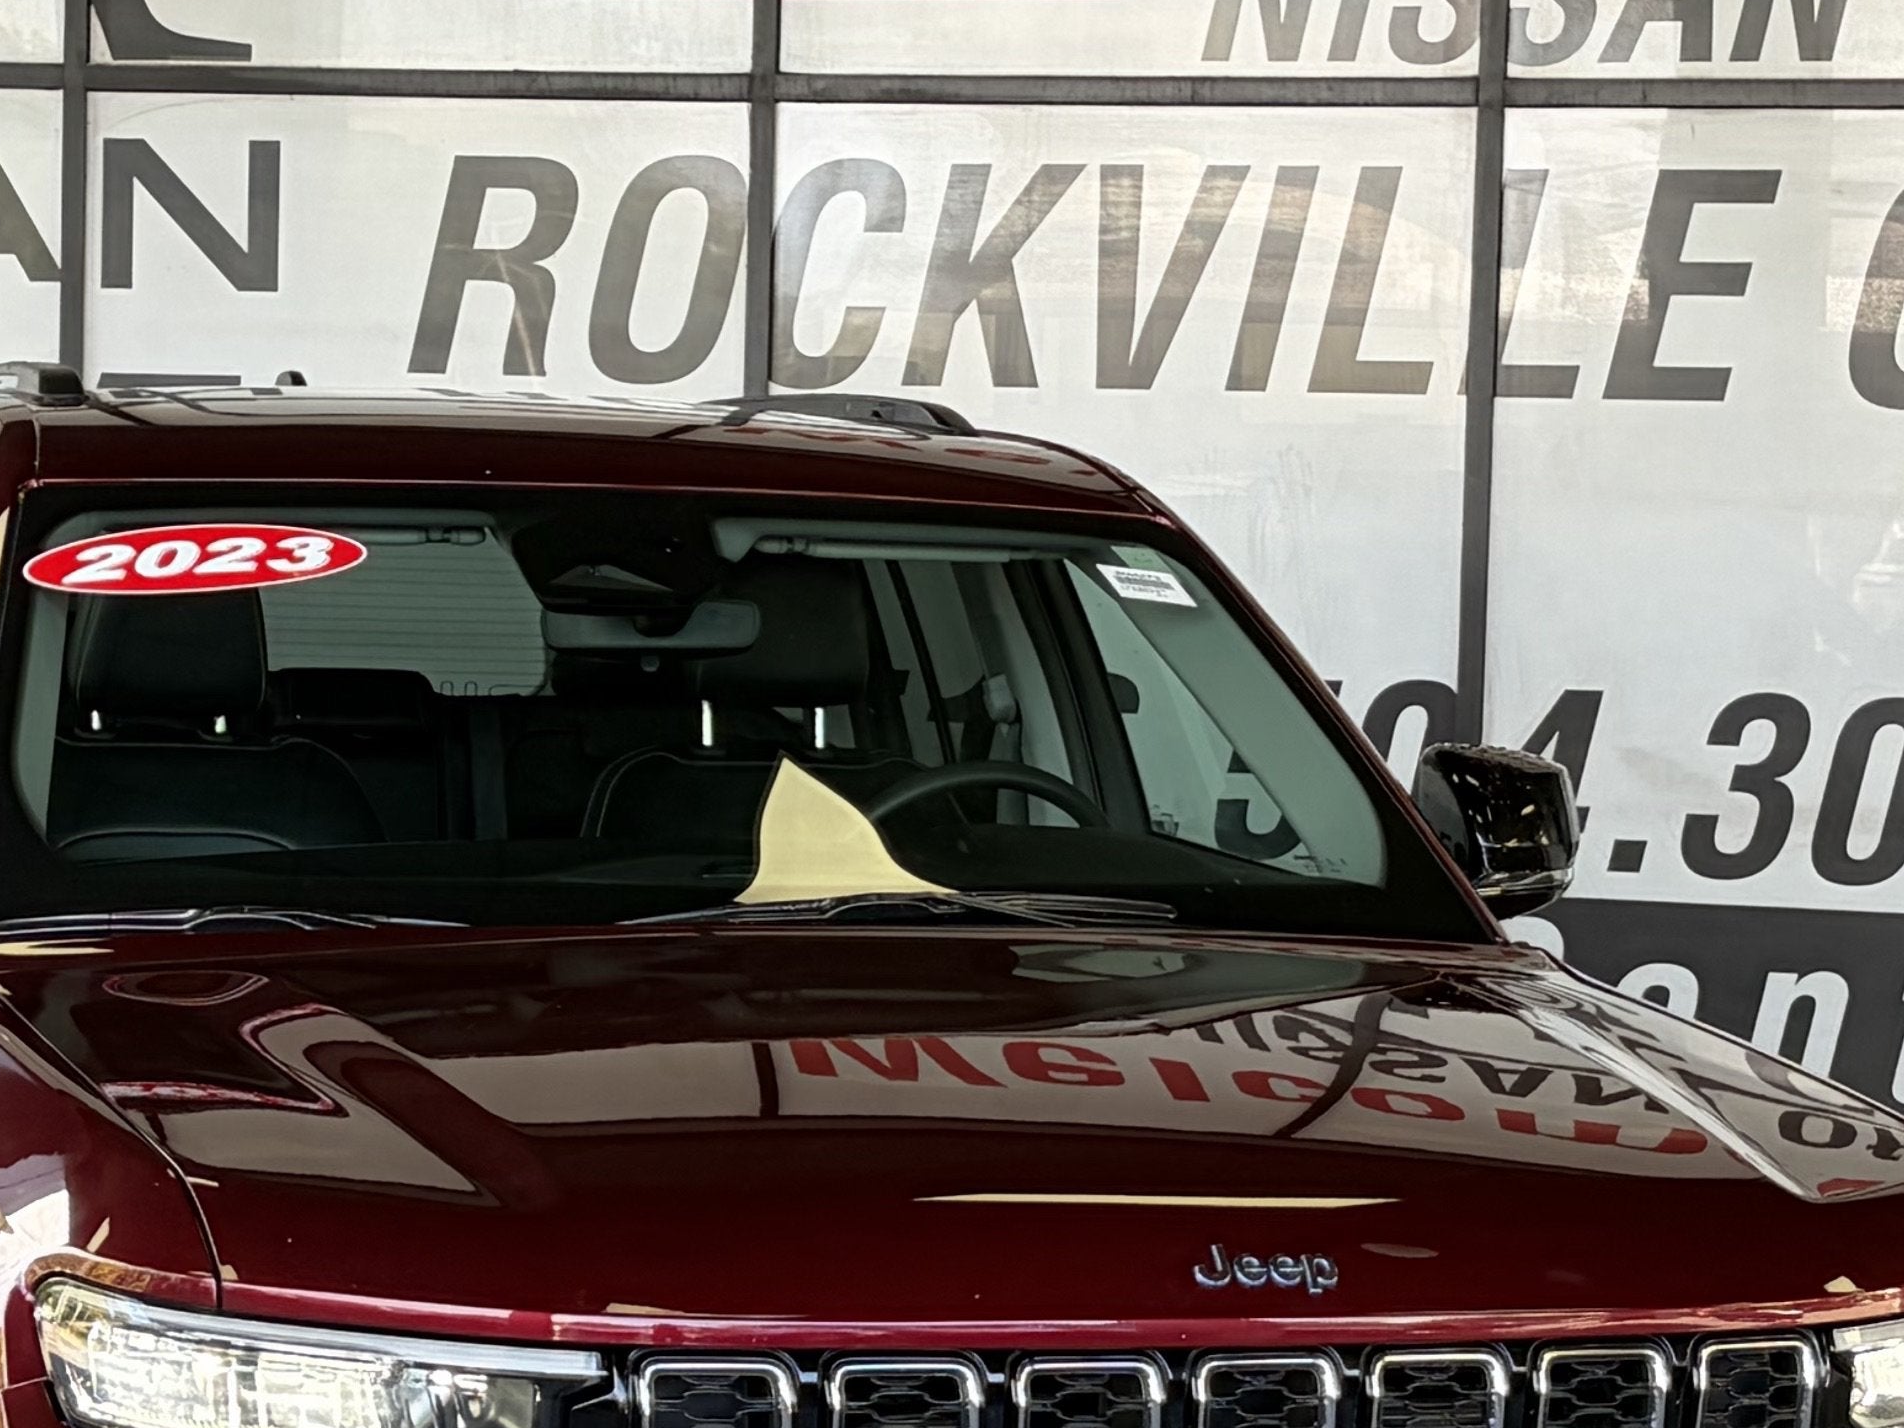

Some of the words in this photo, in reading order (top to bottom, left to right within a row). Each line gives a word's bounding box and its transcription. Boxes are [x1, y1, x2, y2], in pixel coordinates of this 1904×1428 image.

[408, 154, 1780, 401] ROCKVILLE
[61, 536, 334, 585] 2023
[1193, 1243, 1339, 1295] Jeep
